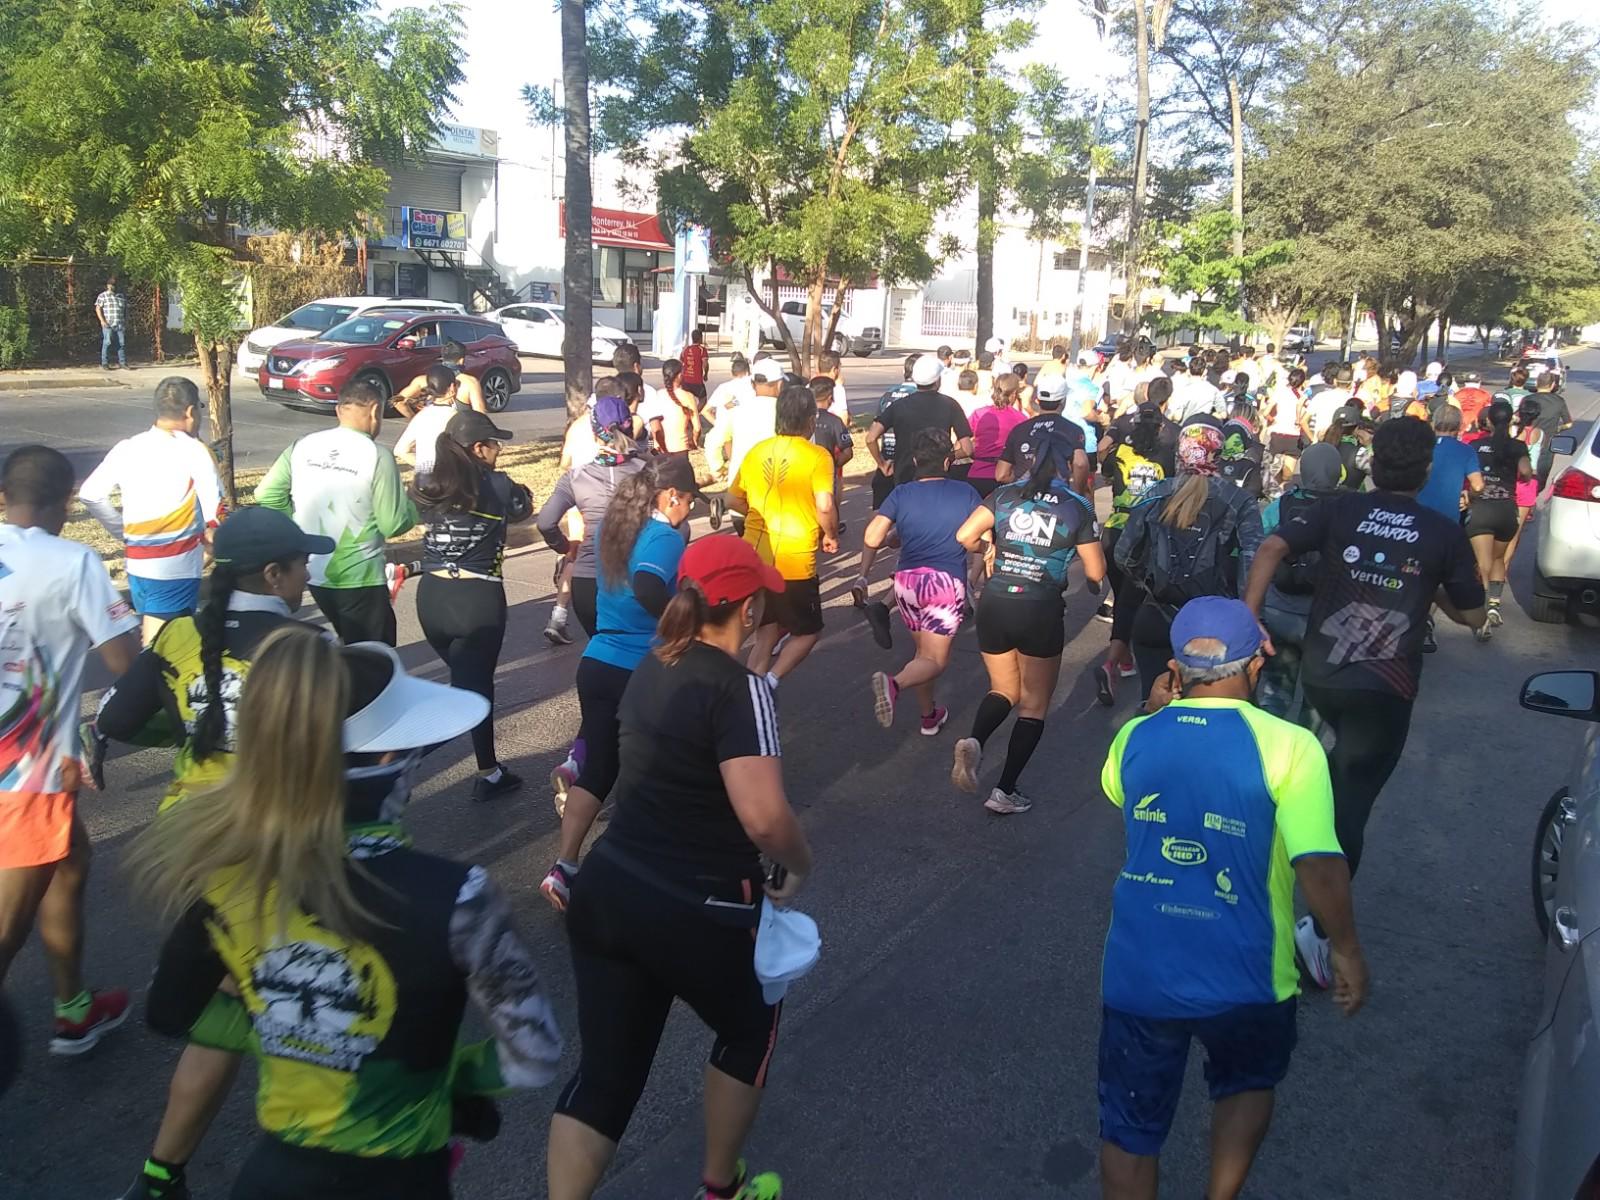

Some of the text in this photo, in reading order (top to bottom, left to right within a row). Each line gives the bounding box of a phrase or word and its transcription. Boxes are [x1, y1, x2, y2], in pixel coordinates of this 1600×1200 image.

[1368, 508, 1415, 526] JORGE
[1356, 520, 1419, 543] EDUARDO
[1177, 715, 1207, 726] VERSA
